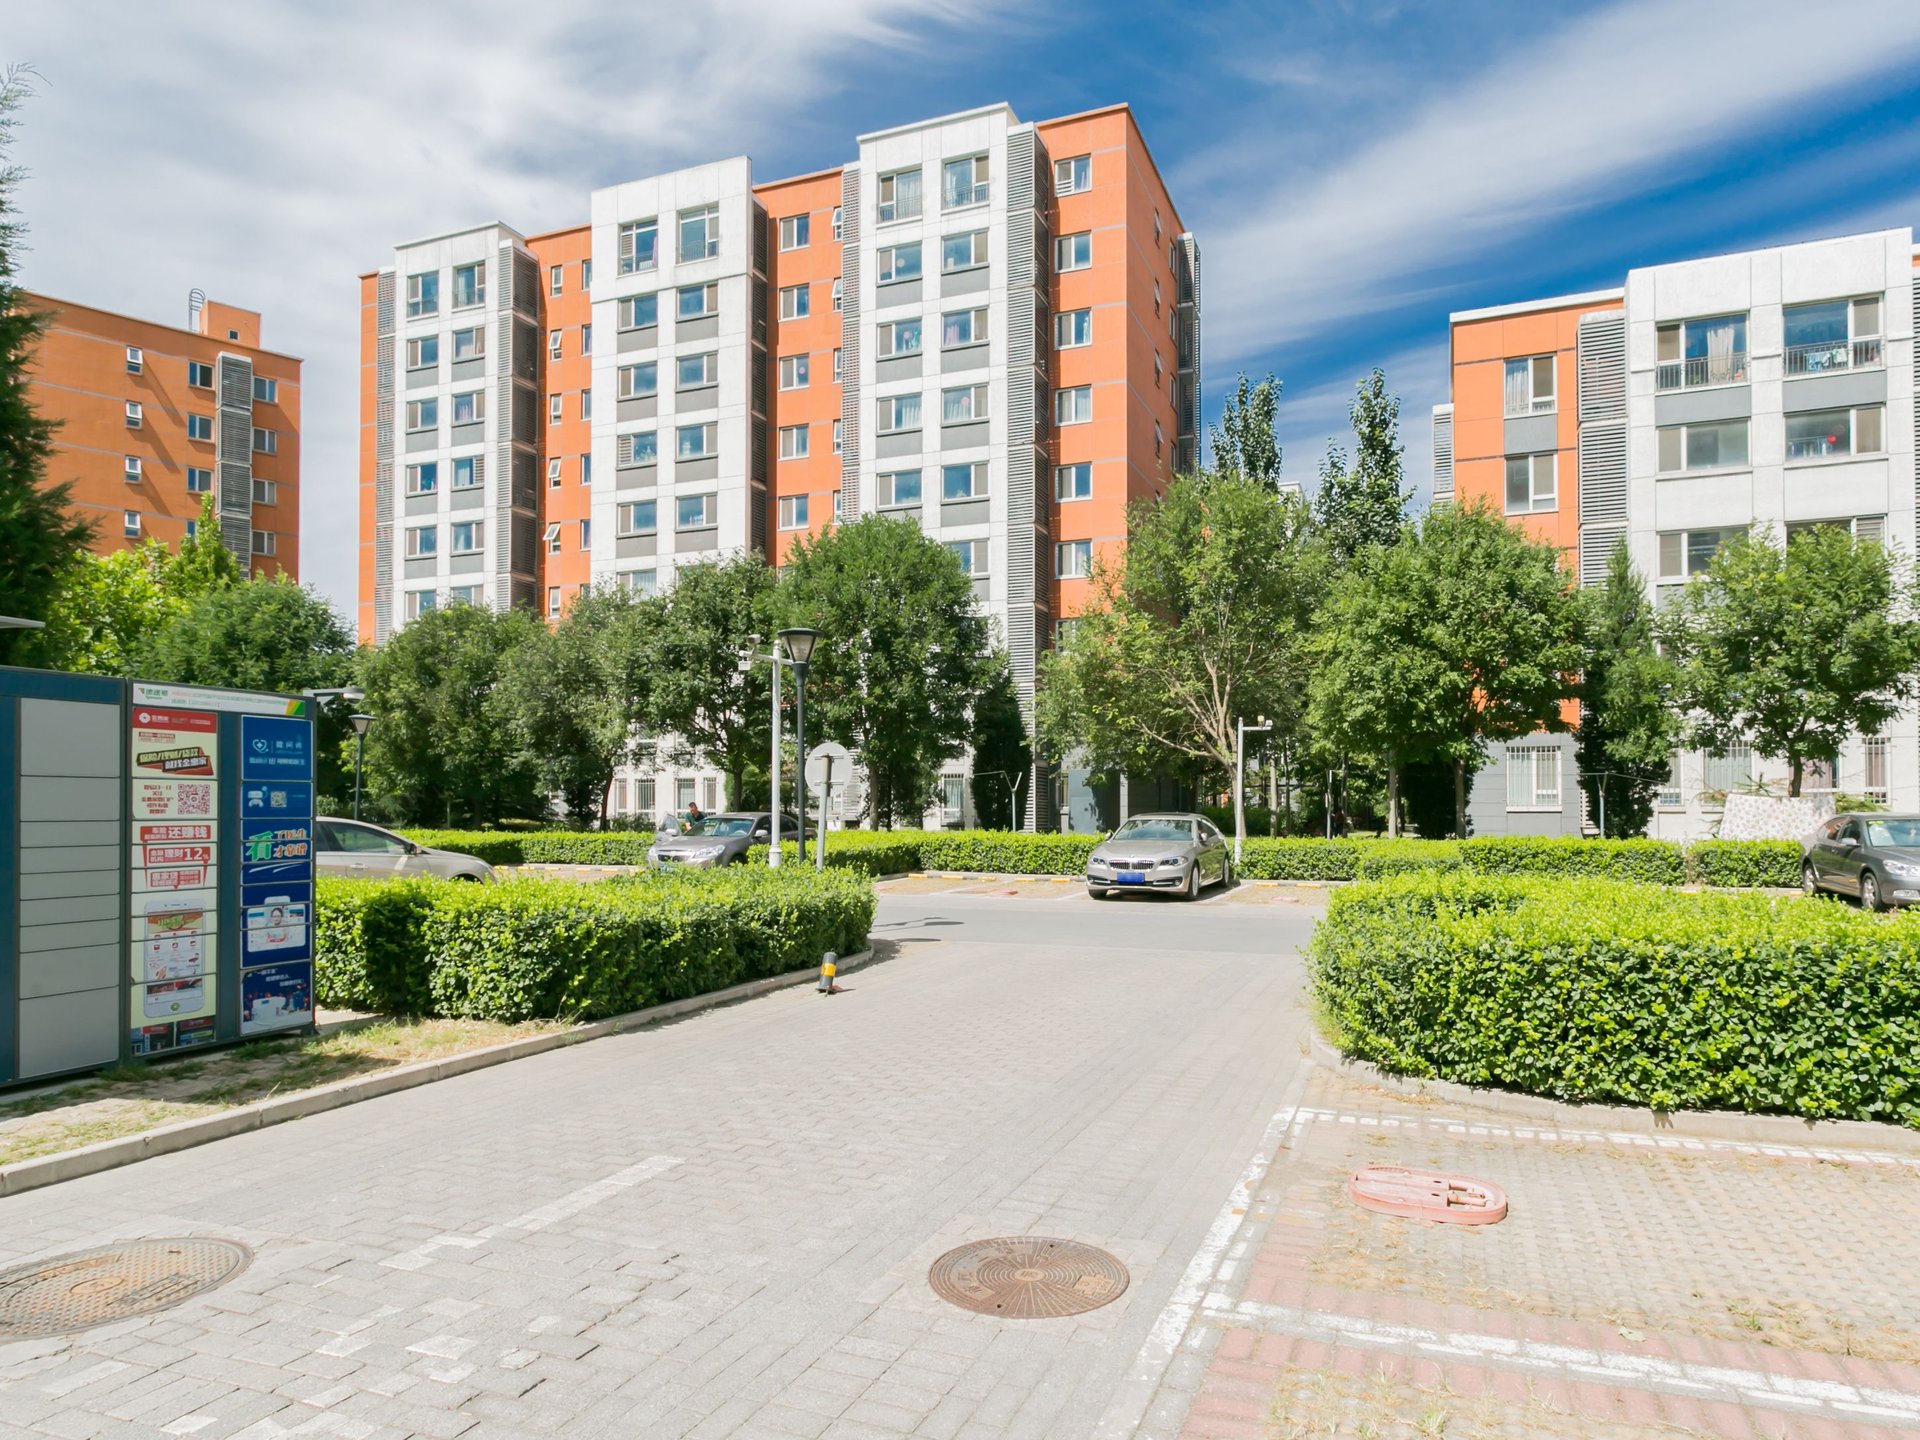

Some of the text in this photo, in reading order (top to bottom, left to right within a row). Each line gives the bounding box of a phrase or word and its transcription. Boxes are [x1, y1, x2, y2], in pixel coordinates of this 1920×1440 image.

[168, 826, 207, 839] 还赚钱
[245, 831, 276, 862] 看
[273, 843, 308, 858] 才靠谱
